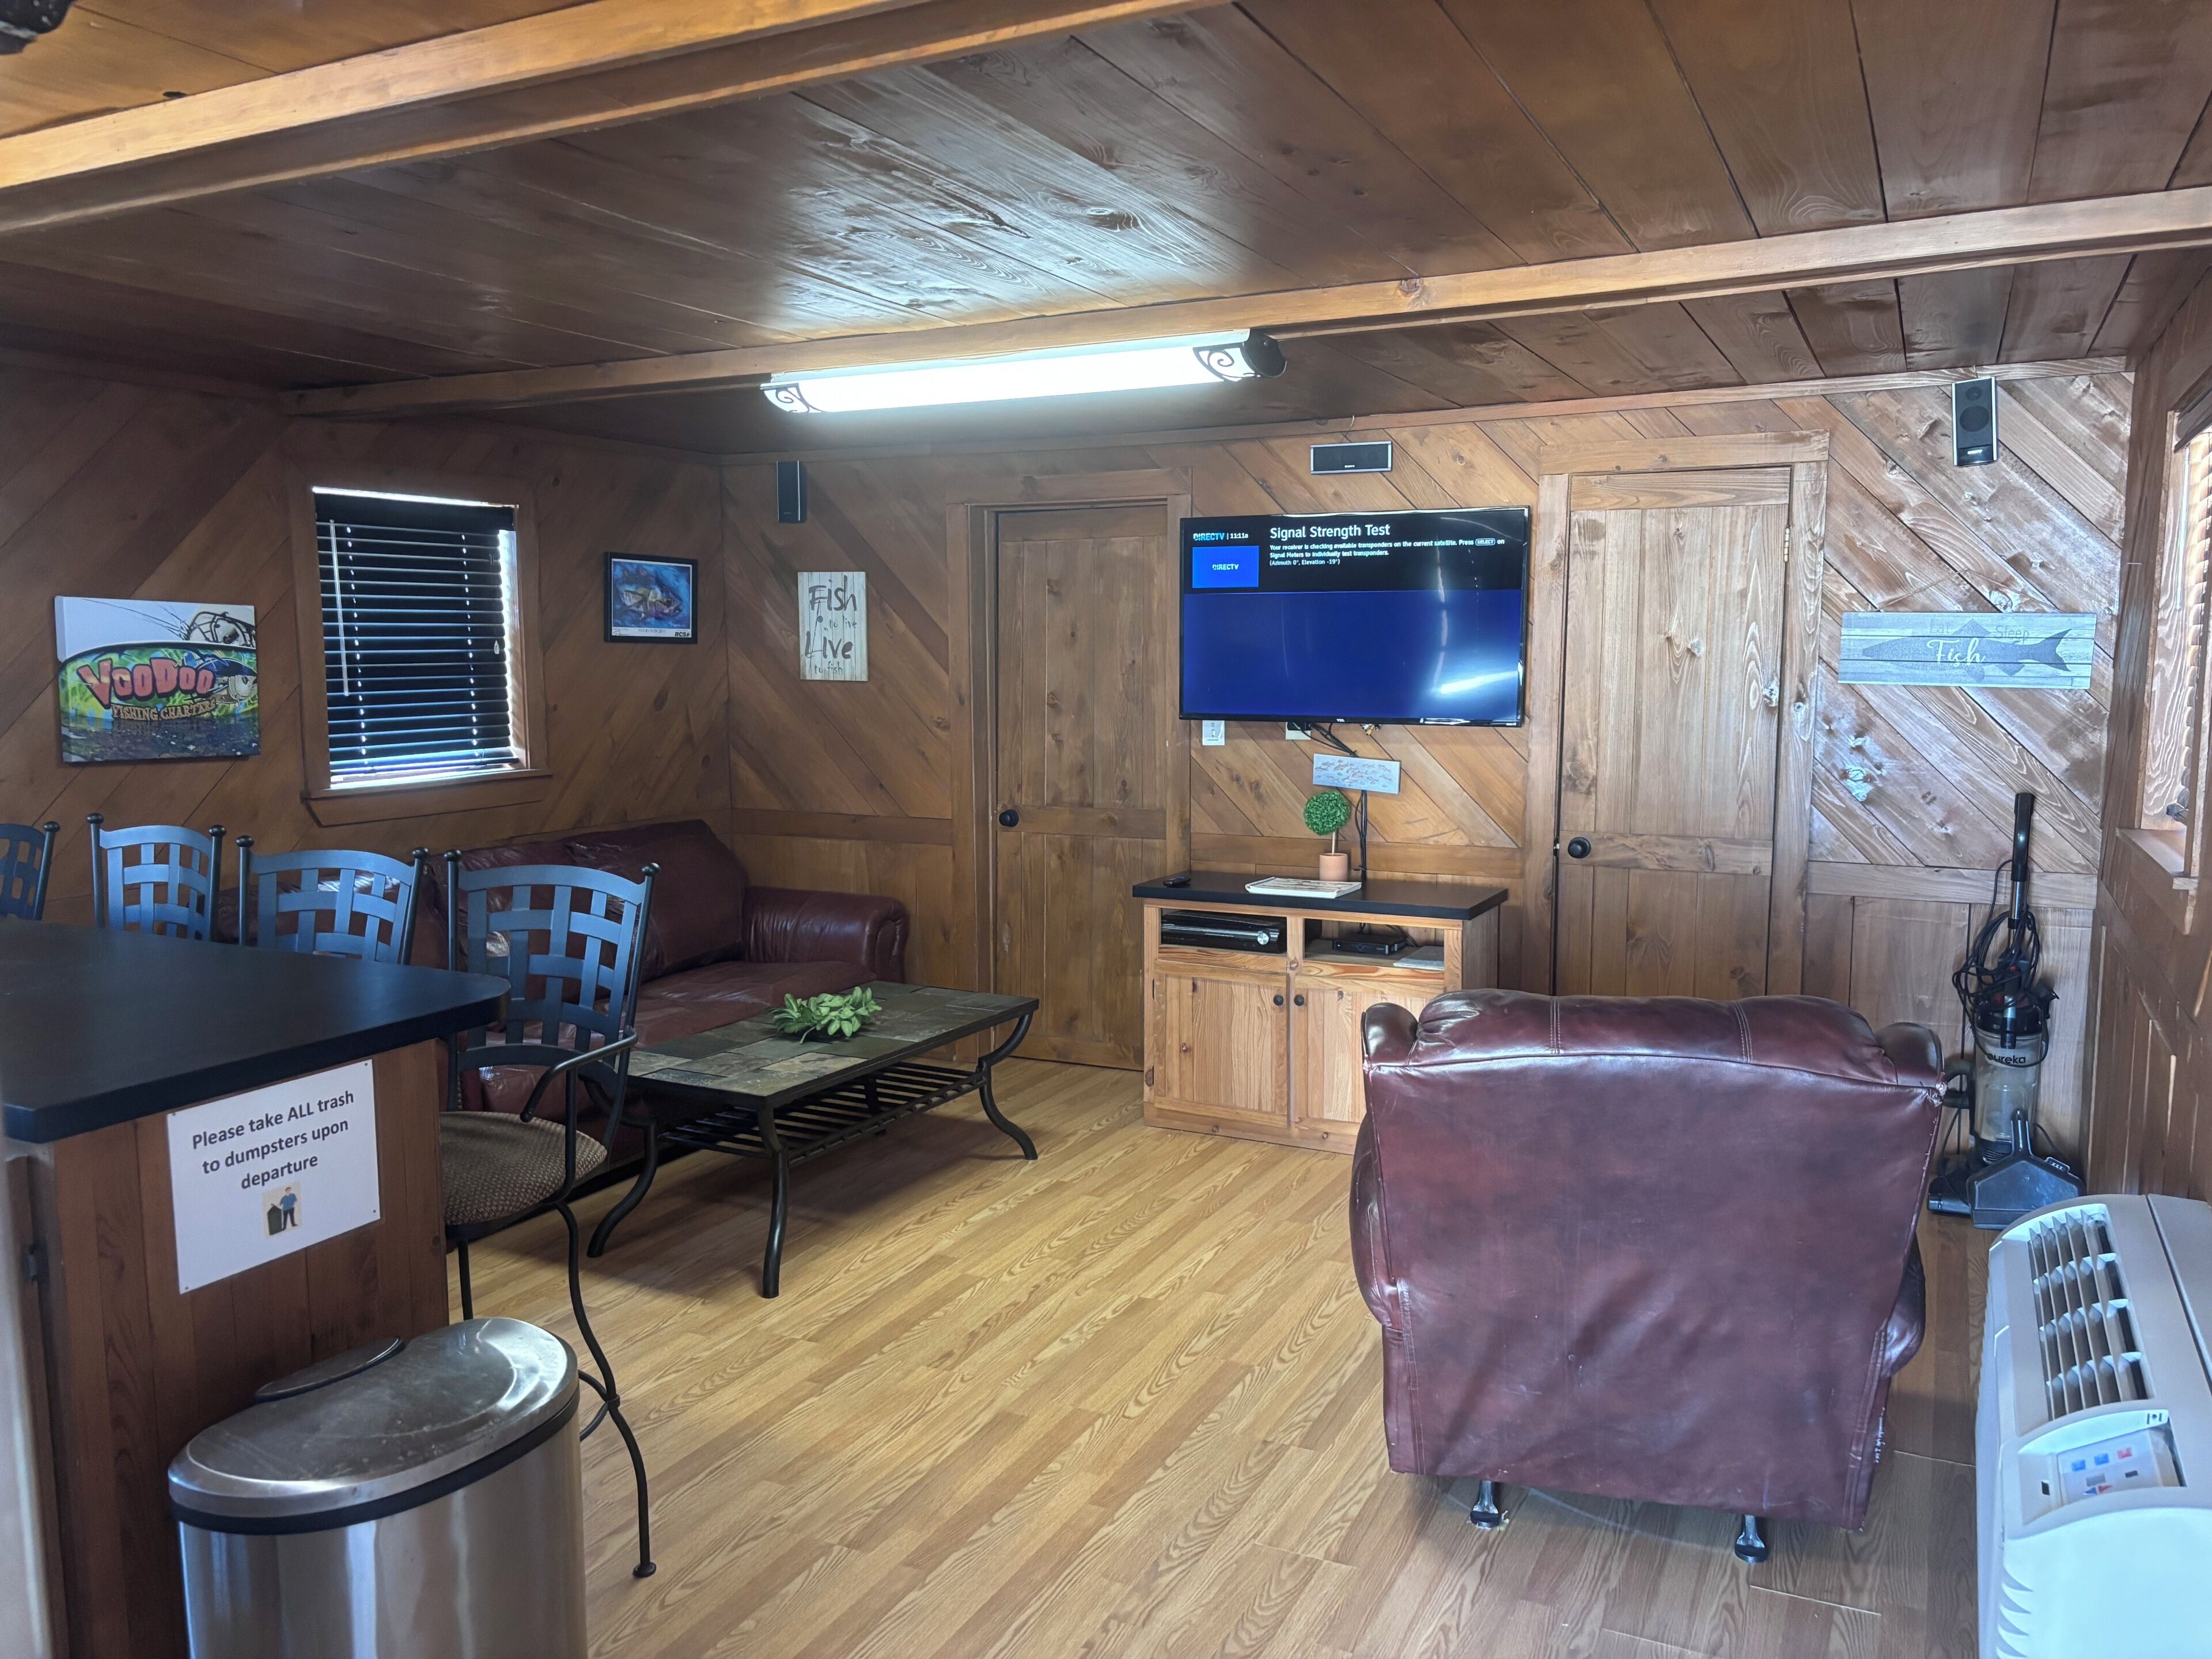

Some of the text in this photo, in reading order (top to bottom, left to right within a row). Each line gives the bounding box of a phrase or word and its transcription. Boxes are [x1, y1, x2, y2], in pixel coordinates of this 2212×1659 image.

[1193, 532, 1225, 541] DIRECTV
[1270, 524, 1391, 541] Signal Strength Test
[809, 575, 857, 611] Fish
[829, 615, 857, 629] to live
[1994, 625, 2029, 645] Sleep
[1927, 637, 1986, 667] Fish
[815, 661, 843, 675] to fish
[111, 698, 217, 721] FISHING CHARTERS
[192, 1090, 355, 1150] Please take ALL trash
[202, 1119, 349, 1175] to dumpsters upon
[241, 1154, 319, 1189] departure
